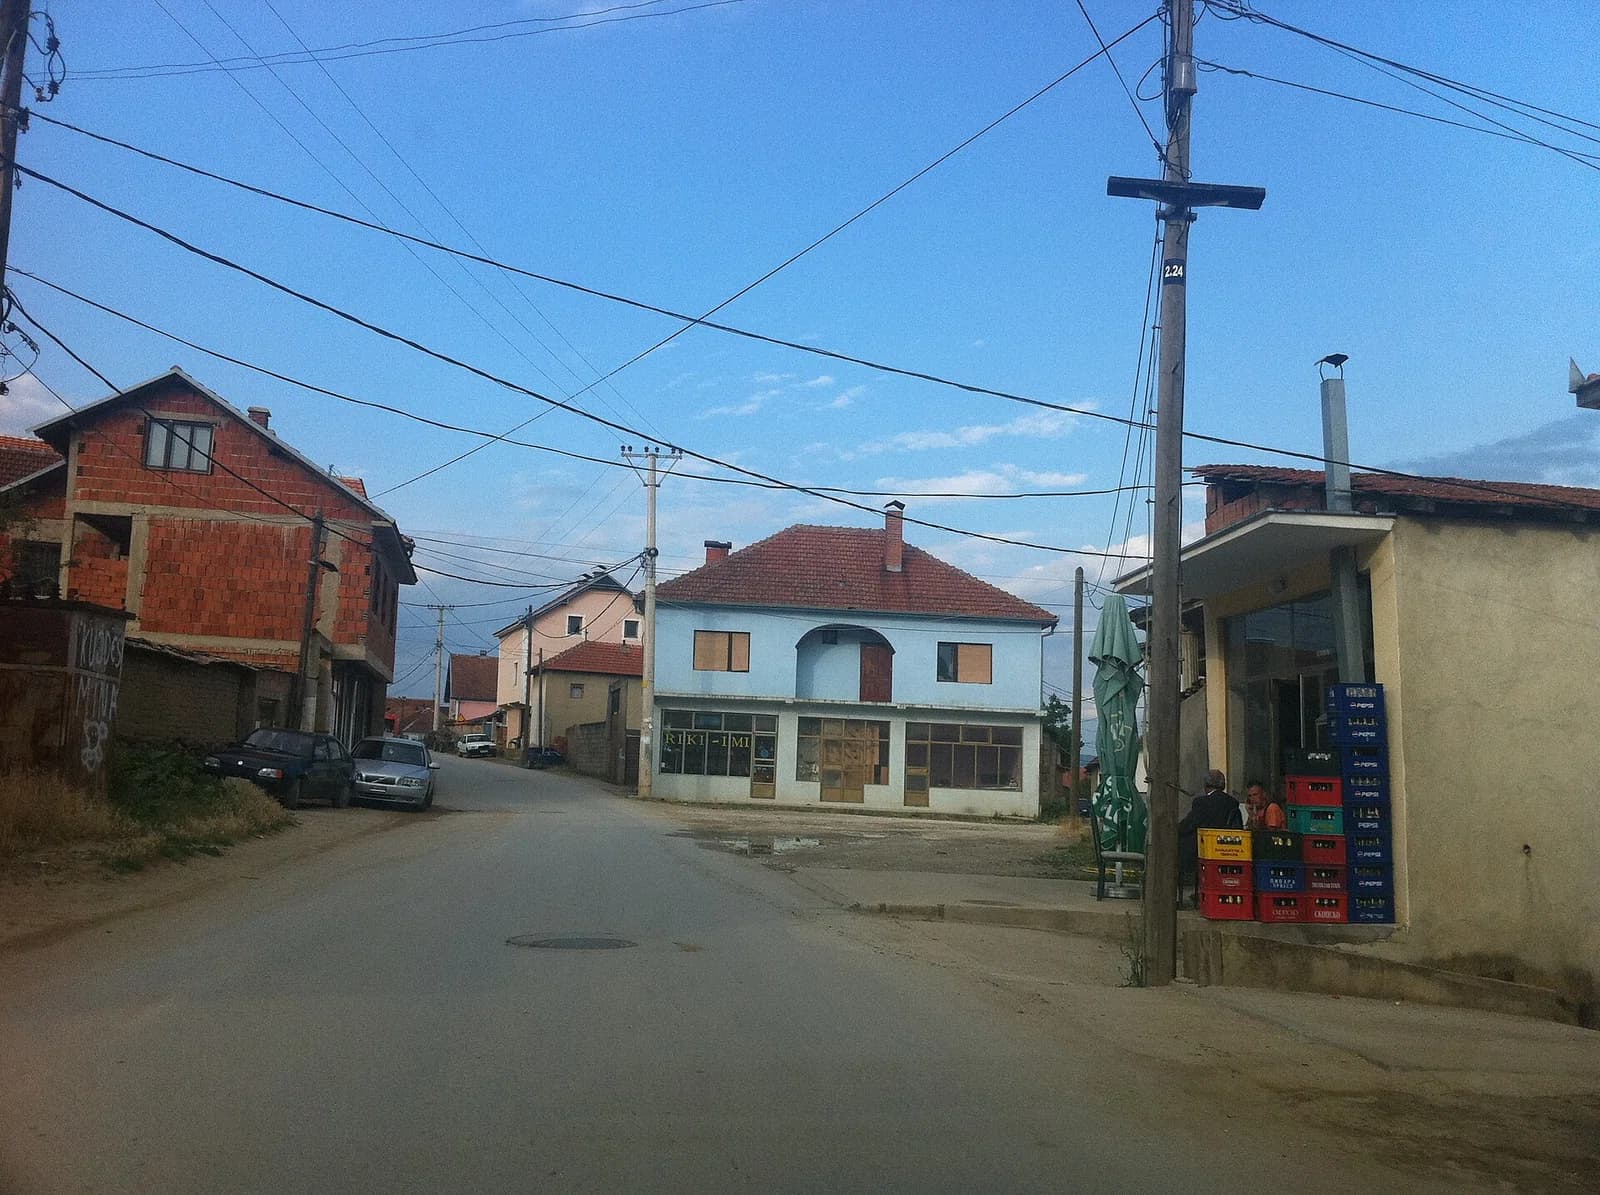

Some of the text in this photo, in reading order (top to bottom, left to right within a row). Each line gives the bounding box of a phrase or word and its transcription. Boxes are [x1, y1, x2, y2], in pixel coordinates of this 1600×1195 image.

[1165, 264, 1183, 278] 2.24
[665, 733, 705, 746] RIKI
[1358, 821, 1379, 829] PEPSI
